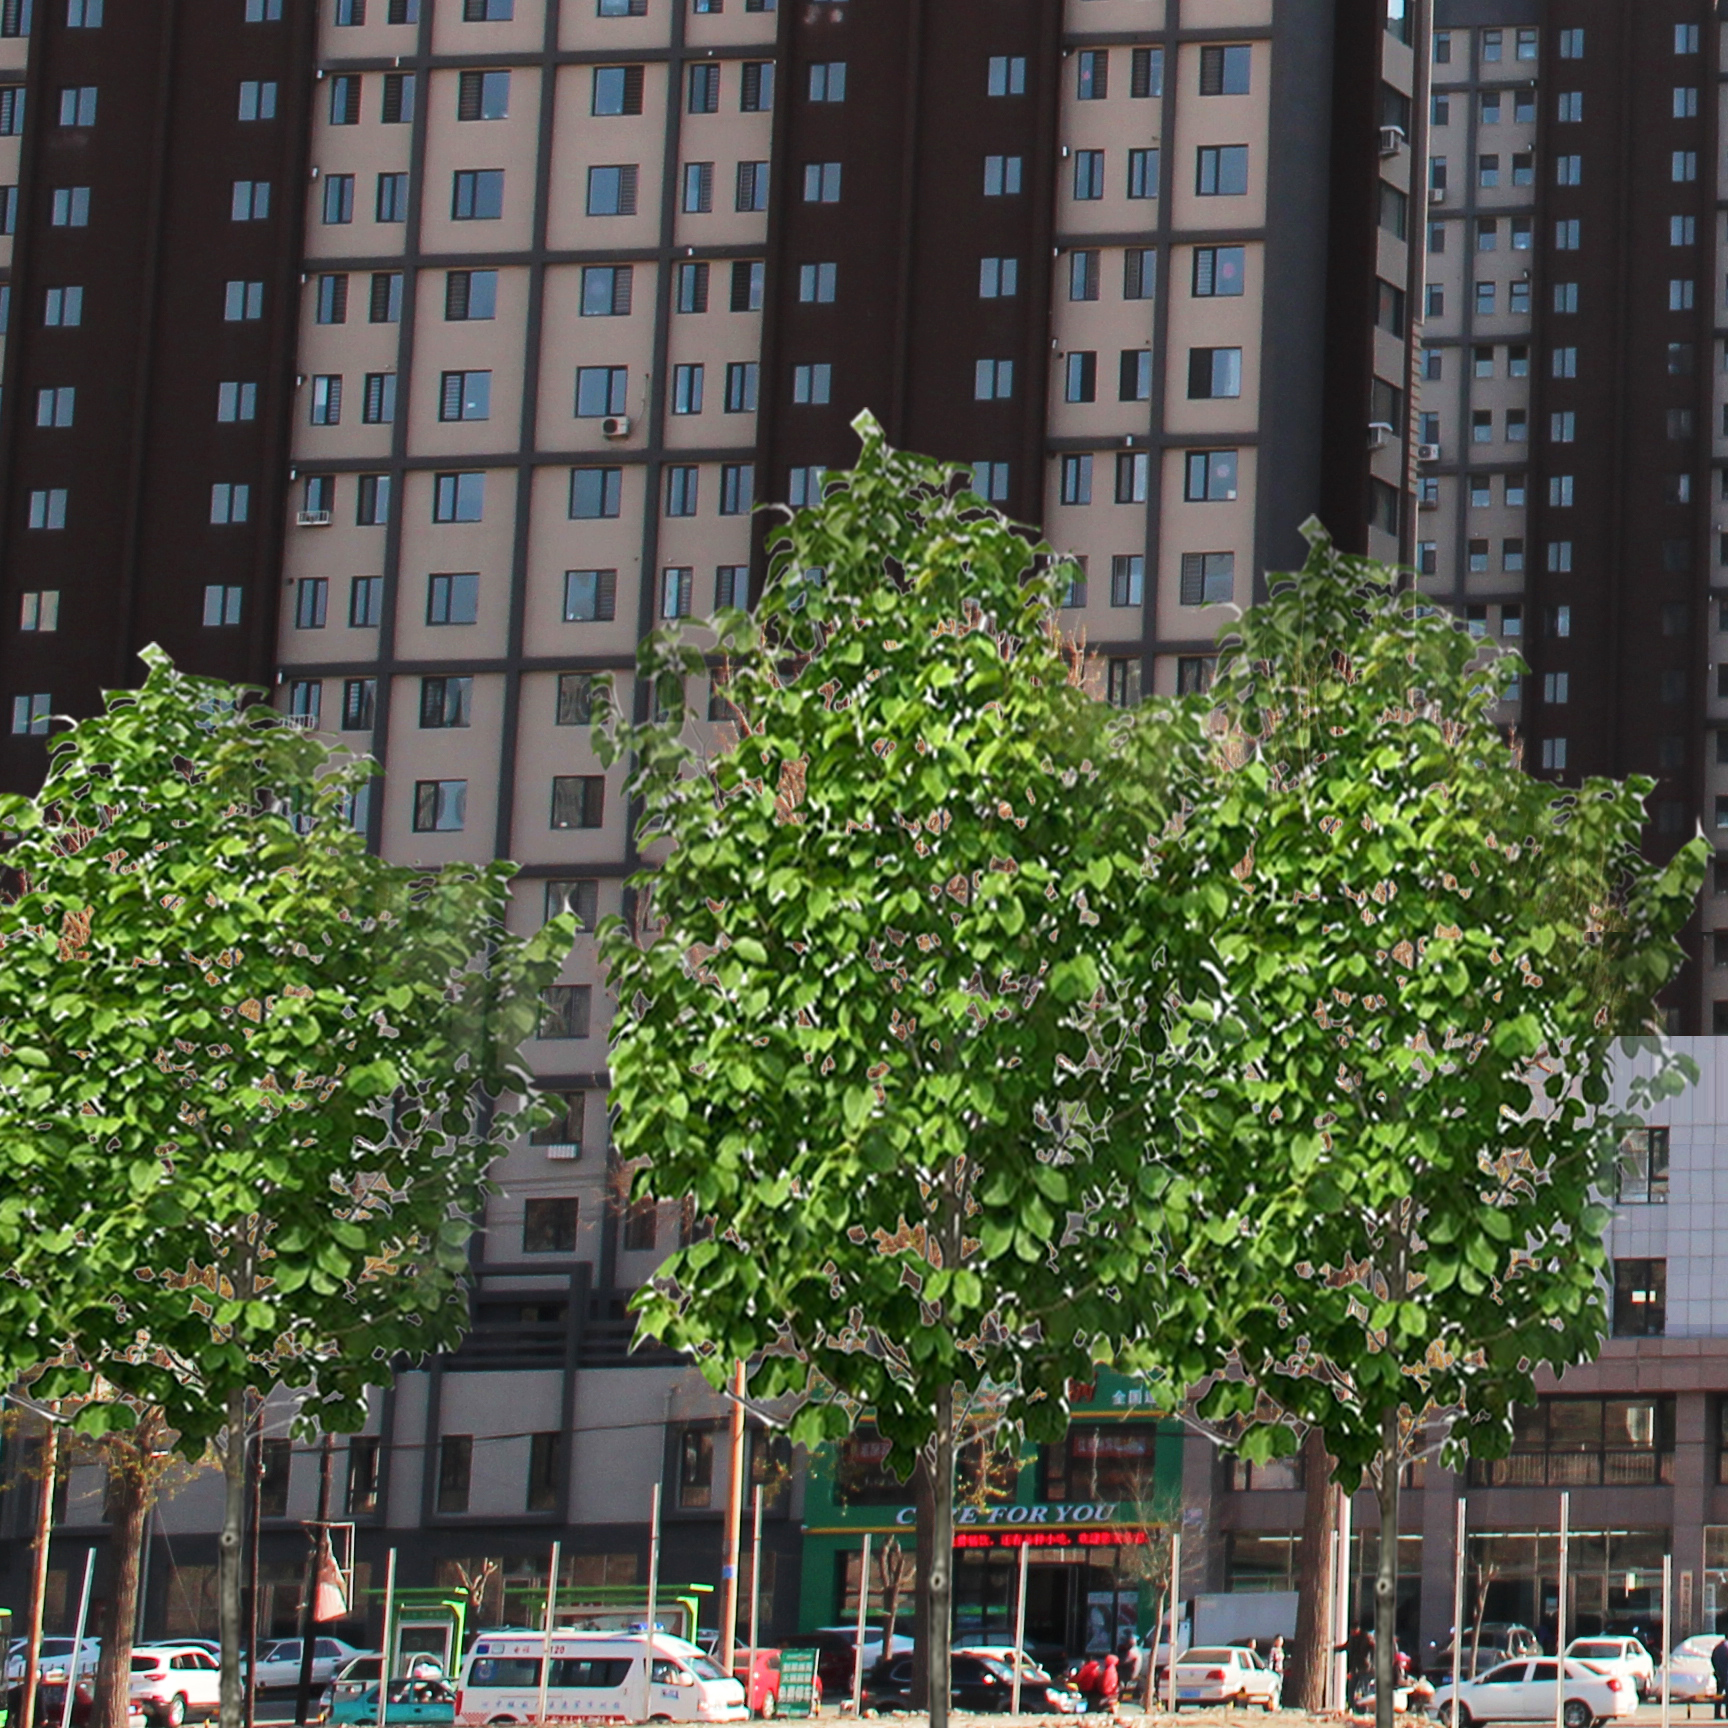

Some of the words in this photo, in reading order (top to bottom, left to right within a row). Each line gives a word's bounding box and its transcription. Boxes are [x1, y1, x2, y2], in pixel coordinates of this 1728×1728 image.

[896, 1505, 978, 1524] CE
[986, 1504, 1048, 1524] FOR
[1055, 1503, 1117, 1522] YOU
